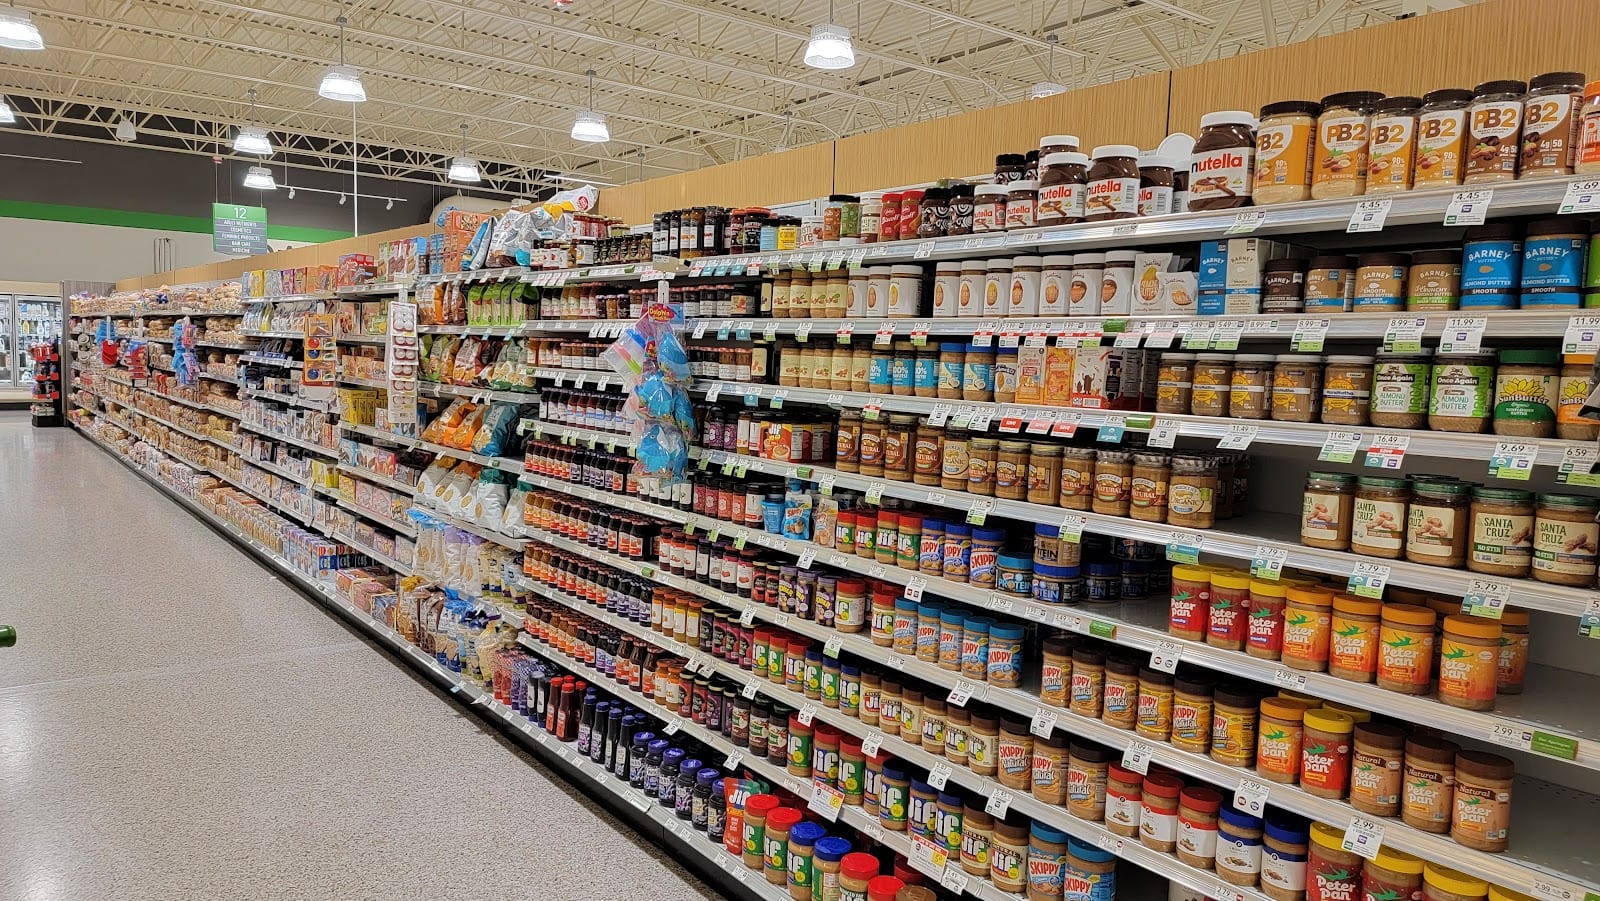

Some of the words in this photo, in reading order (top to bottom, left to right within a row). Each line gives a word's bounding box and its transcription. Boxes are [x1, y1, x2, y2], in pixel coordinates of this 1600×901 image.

[1474, 108, 1517, 131] PB2
[1327, 123, 1367, 143] PB2
[1419, 119, 1457, 139] PB2
[1191, 153, 1243, 174] nutella
[1087, 180, 1121, 196] nutella
[1572, 182, 1599, 191] 5.69
[1039, 186, 1072, 200] nutella
[1456, 192, 1480, 200] 4.45
[1360, 201, 1380, 209] 4.45
[233, 207, 247, 219] 12
[1469, 250, 1511, 262] BARNEY
[1525, 247, 1569, 260] BARNEY
[1362, 270, 1391, 280] BARNEY
[1420, 270, 1451, 279] BARNEY
[1391, 374, 1413, 382] Again
[1454, 377, 1478, 385] Again
[1380, 392, 1405, 400] ALMOND
[1441, 395, 1469, 404] ALMOND
[1499, 395, 1549, 404] SunButter
[1380, 399, 1404, 407] BUTTER
[1441, 402, 1467, 411] BUTTER
[1377, 435, 1398, 443] 16.49
[1500, 444, 1525, 452] 9.69
[1566, 448, 1587, 457] 6.59
[1356, 501, 1377, 514] SANTA
[1356, 511, 1374, 521] CRUZ
[1484, 517, 1513, 529] SANTA
[1486, 527, 1511, 538] CRUZ
[1540, 523, 1567, 536] SANTA
[1541, 533, 1563, 544] CRUZ
[1488, 545, 1501, 553] STIR
[1359, 563, 1379, 572] 5.79
[1474, 581, 1498, 591] 5.79
[1171, 599, 1196, 611] Peter
[1210, 606, 1237, 619] Peter
[1249, 615, 1277, 629] Peter
[1285, 623, 1314, 636] Peter
[1159, 640, 1175, 649] 2.99
[1333, 633, 1367, 648] Peter
[1383, 643, 1418, 658] Peter
[1277, 671, 1292, 680] 2.99
[1494, 725, 1513, 736] 2.99
[1260, 737, 1291, 750] Peter
[1000, 745, 1025, 759] SKIPPY
[1303, 752, 1335, 767] Peter
[1355, 753, 1381, 765] Natural
[1353, 767, 1383, 783] Peter
[1408, 768, 1438, 781] Natural
[1242, 779, 1261, 790] 2.99
[1407, 784, 1438, 799] Peter
[1459, 784, 1491, 798] Natural
[1458, 799, 1492, 816] Peter
[1353, 818, 1374, 830] 2.99
[1029, 861, 1060, 875] SKIPPY
[1316, 875, 1356, 893] Peter
